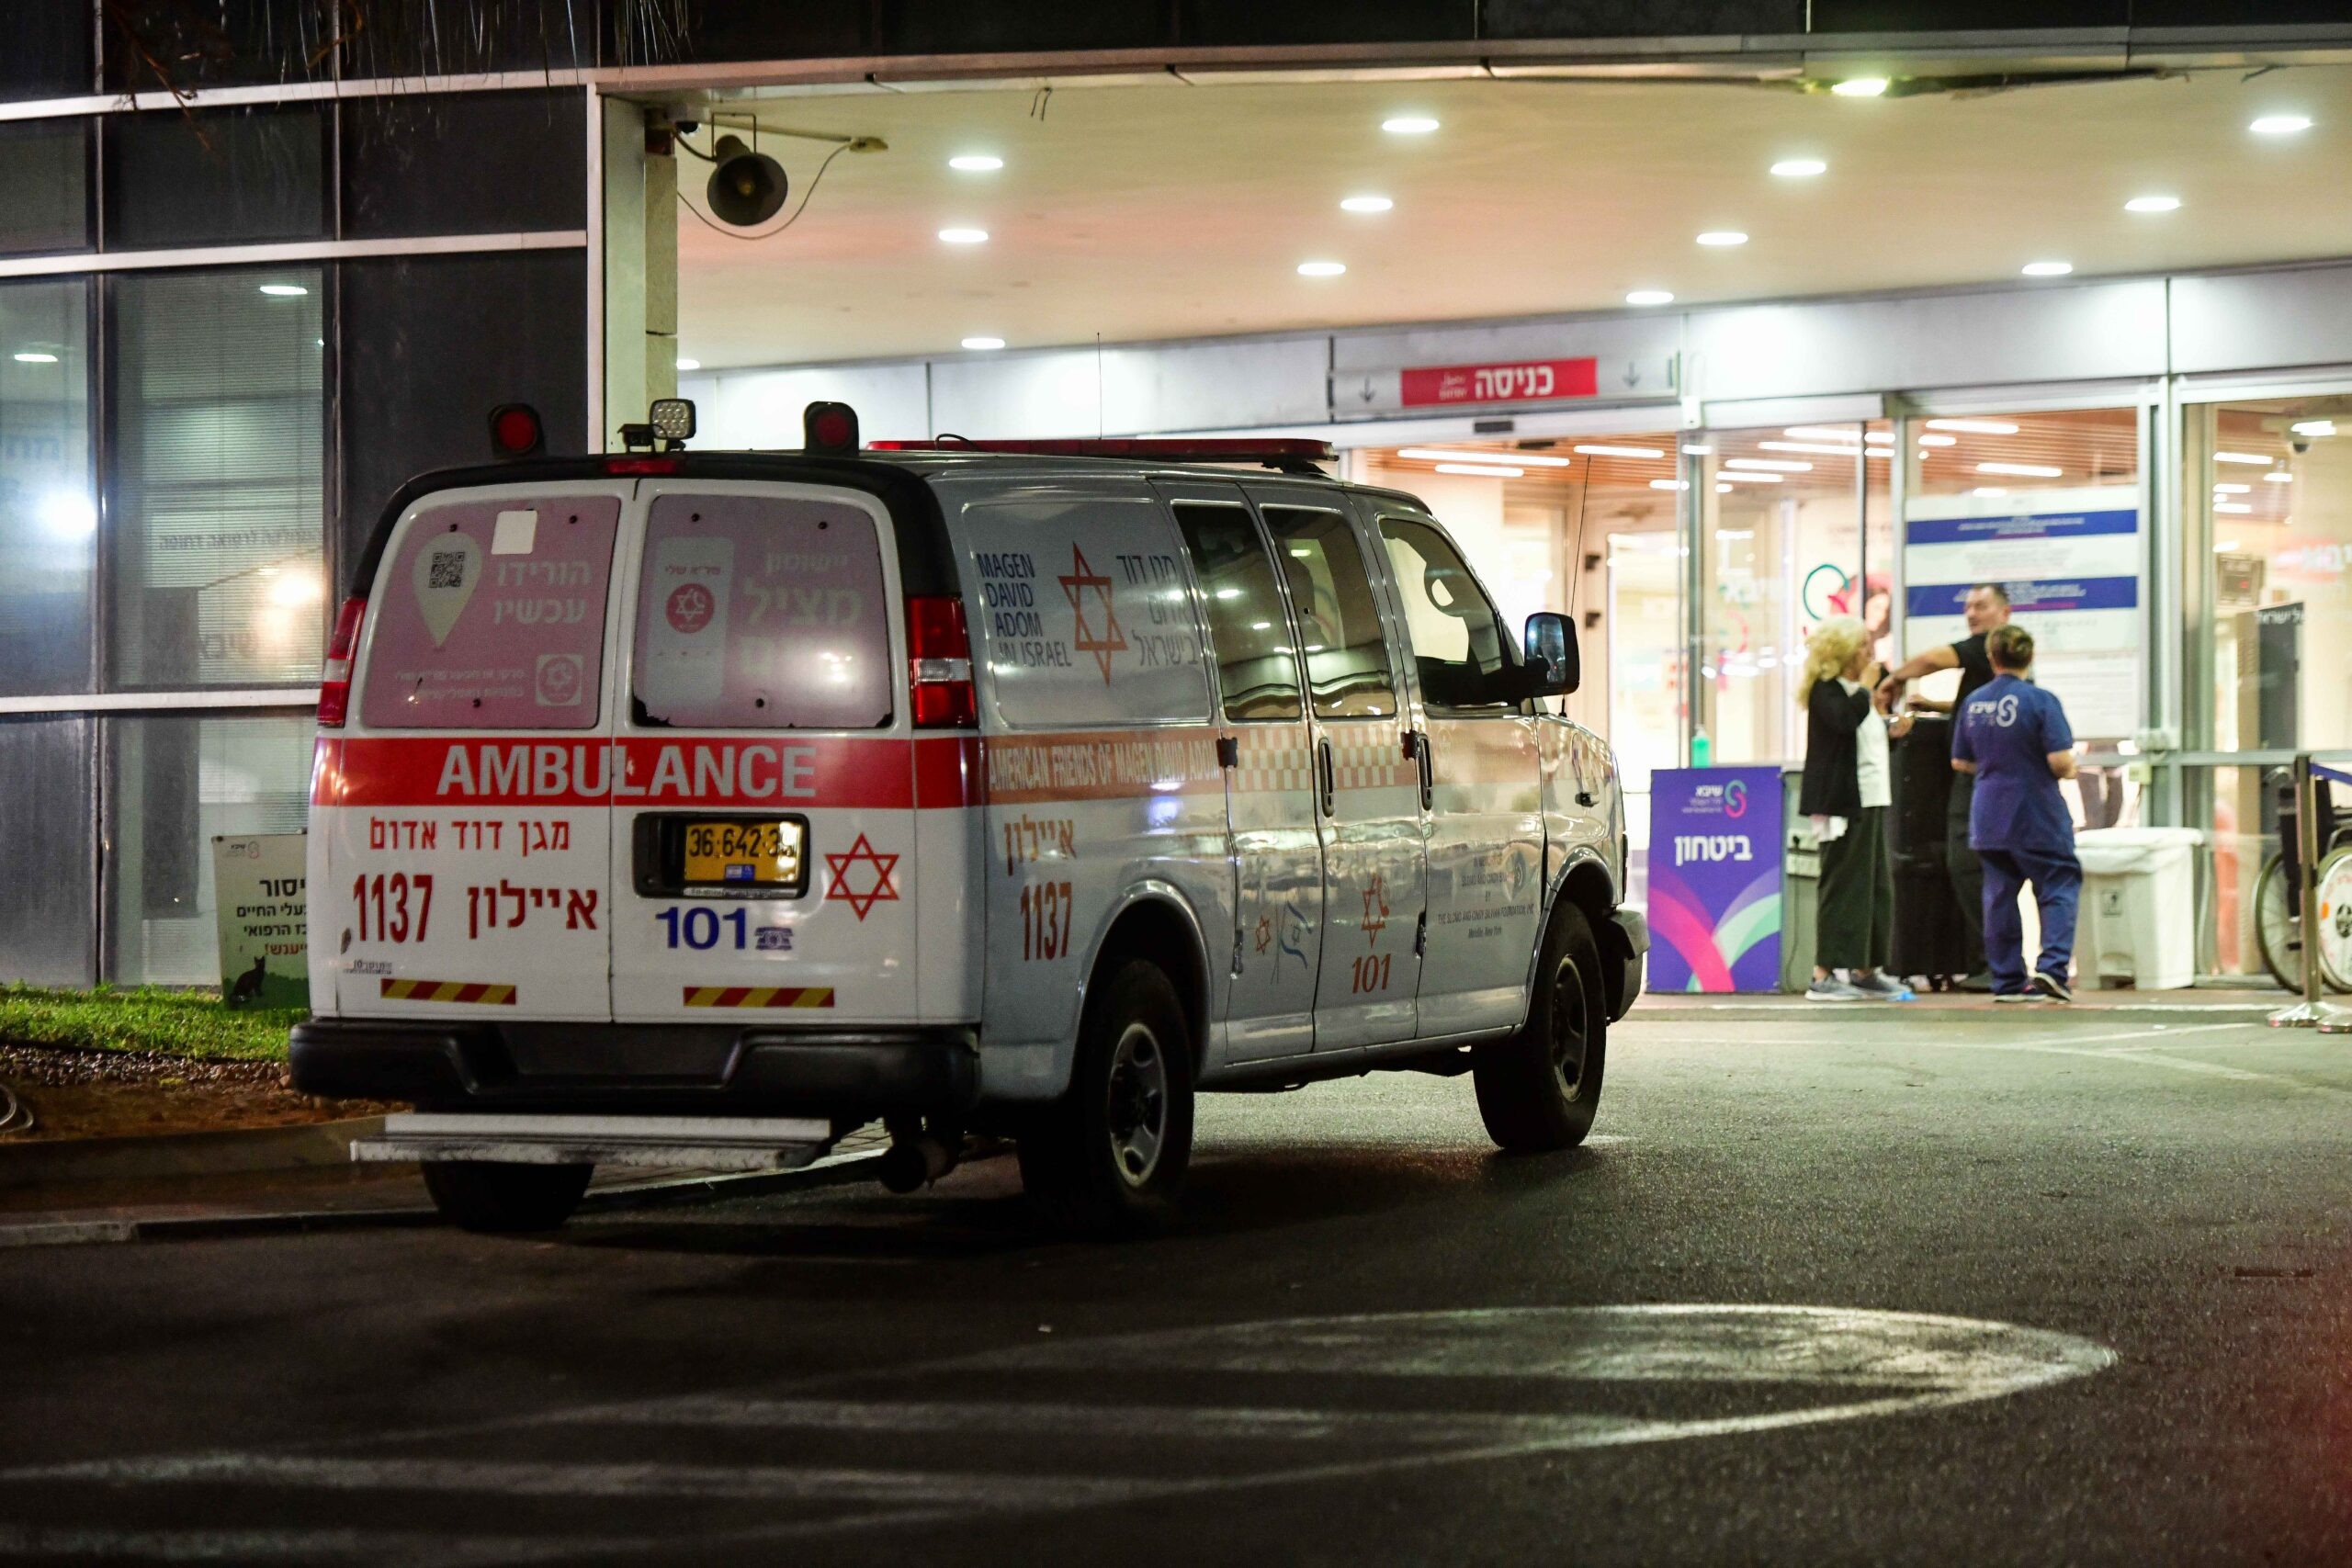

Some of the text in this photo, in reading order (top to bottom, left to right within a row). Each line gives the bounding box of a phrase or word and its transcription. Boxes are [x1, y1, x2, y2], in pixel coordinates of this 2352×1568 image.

[1474, 365, 1555, 400] כניסה
[496, 559, 594, 587] הורידו
[976, 553, 1035, 579] MAGEN
[1115, 554, 1148, 585] דוד
[742, 575, 865, 626] מציל
[984, 581, 1035, 609] DAVID
[492, 598, 588, 626] עכשיו
[994, 611, 1044, 637] ADOM
[1021, 641, 1072, 668] ISRAEL
[436, 743, 817, 798] AMBULANCE
[369, 815, 571, 856] מגן דוד אדום
[1004, 814, 1077, 876] איילון
[1674, 834, 1753, 866] ביטחון
[259, 878, 307, 897] יסור
[236, 902, 307, 918] עלי החיים
[353, 873, 598, 943] איילון 1137
[1020, 881, 1072, 962] 1137
[243, 923, 291, 937] הרפואי
[655, 906, 748, 951] 101
[1351, 953, 1391, 994] 101
